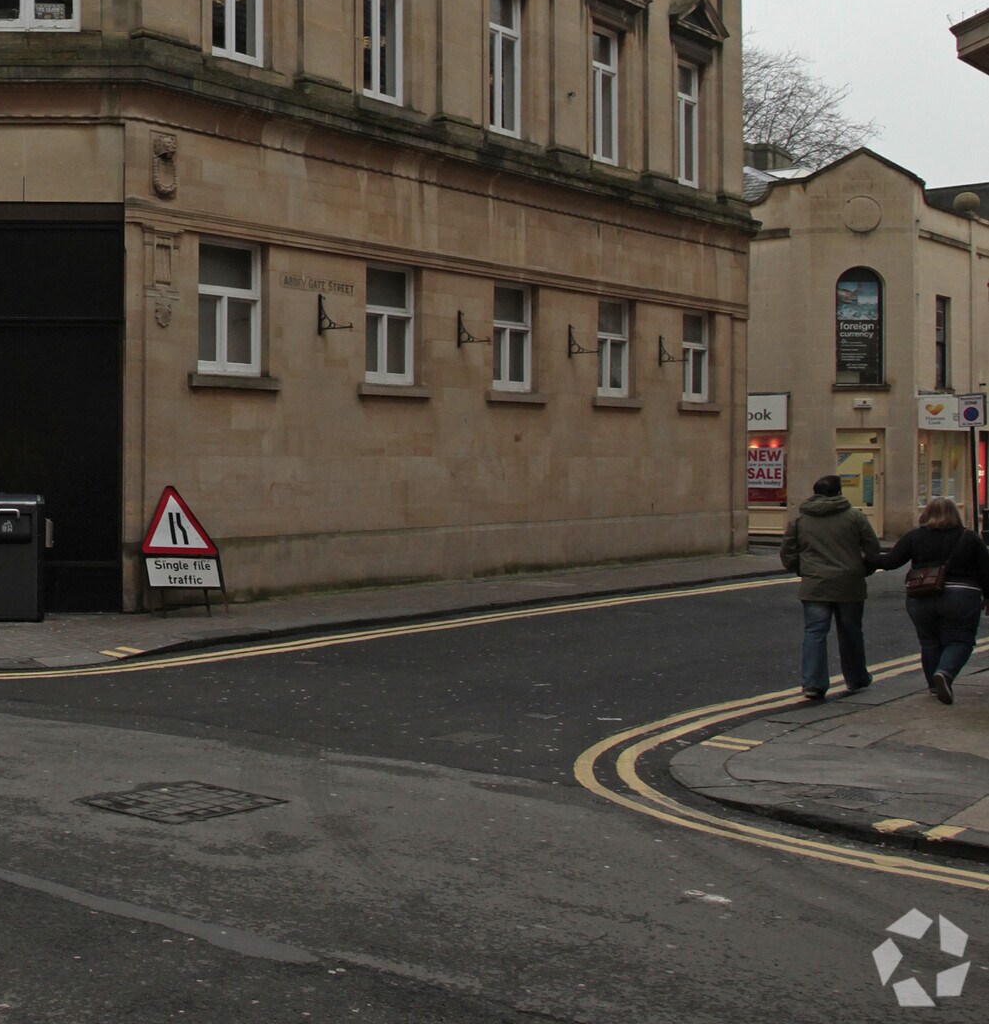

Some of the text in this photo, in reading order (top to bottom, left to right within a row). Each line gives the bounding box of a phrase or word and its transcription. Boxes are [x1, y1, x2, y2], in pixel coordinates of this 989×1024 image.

[283, 276, 355, 295] ABBEY GATE STREET
[839, 322, 874, 332] foreign
[839, 330, 874, 339] currency
[748, 450, 782, 462] NEW
[748, 468, 782, 480] SALE
[154, 560, 211, 572] Single file
[168, 574, 203, 585] traffic
